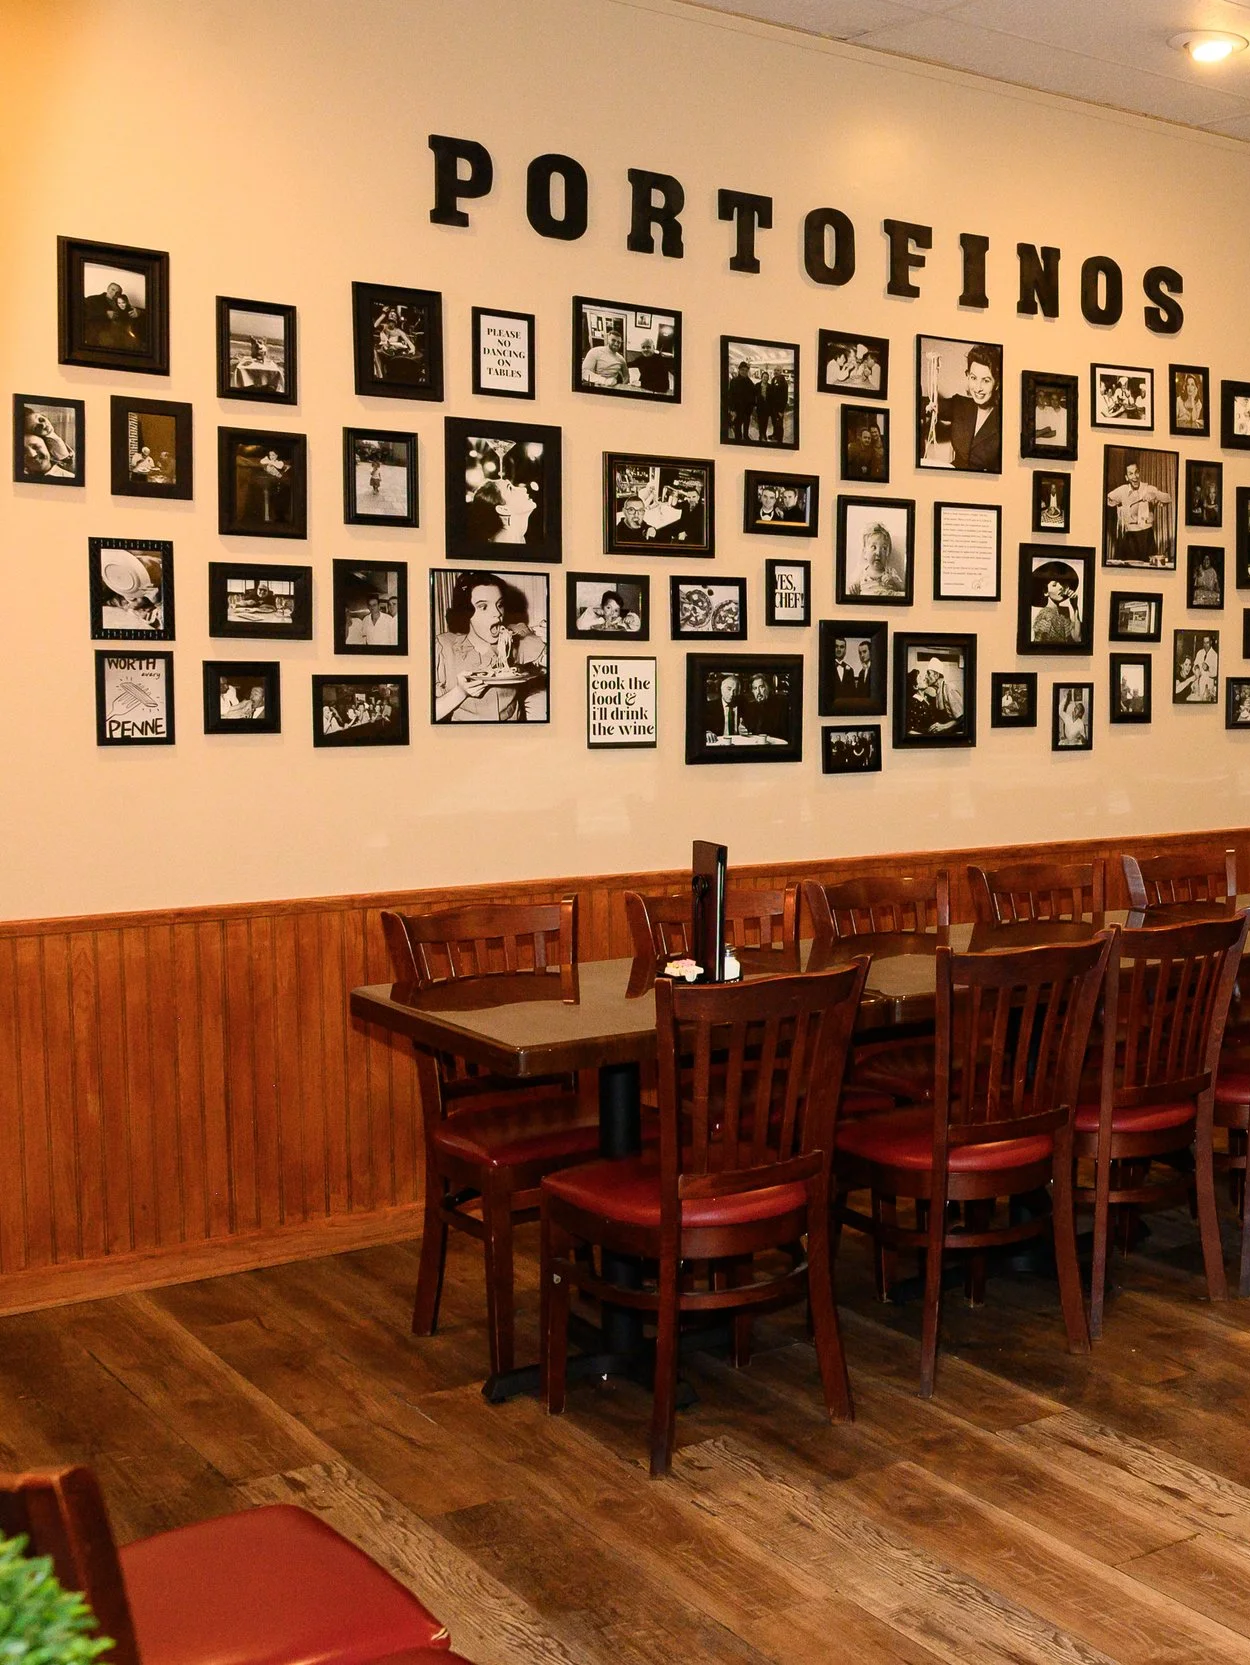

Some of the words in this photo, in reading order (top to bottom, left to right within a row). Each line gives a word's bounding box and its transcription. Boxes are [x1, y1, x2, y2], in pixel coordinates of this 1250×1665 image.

[429, 135, 1183, 334] PORTOFINOS
[487, 327, 522, 340] PLEASE
[497, 338, 511, 348] NO
[483, 347, 525, 359] DANCING
[497, 358, 511, 367] ON
[486, 367, 522, 378] TABLES
[107, 658, 157, 671] WORTH
[592, 664, 619, 677] you
[591, 676, 625, 690] cook
[628, 676, 651, 690] the
[592, 691, 622, 706] food
[624, 692, 637, 706] &
[610, 706, 649, 721] drink
[108, 717, 166, 738] PENNE
[592, 722, 615, 736] the
[618, 721, 655, 736] wine
